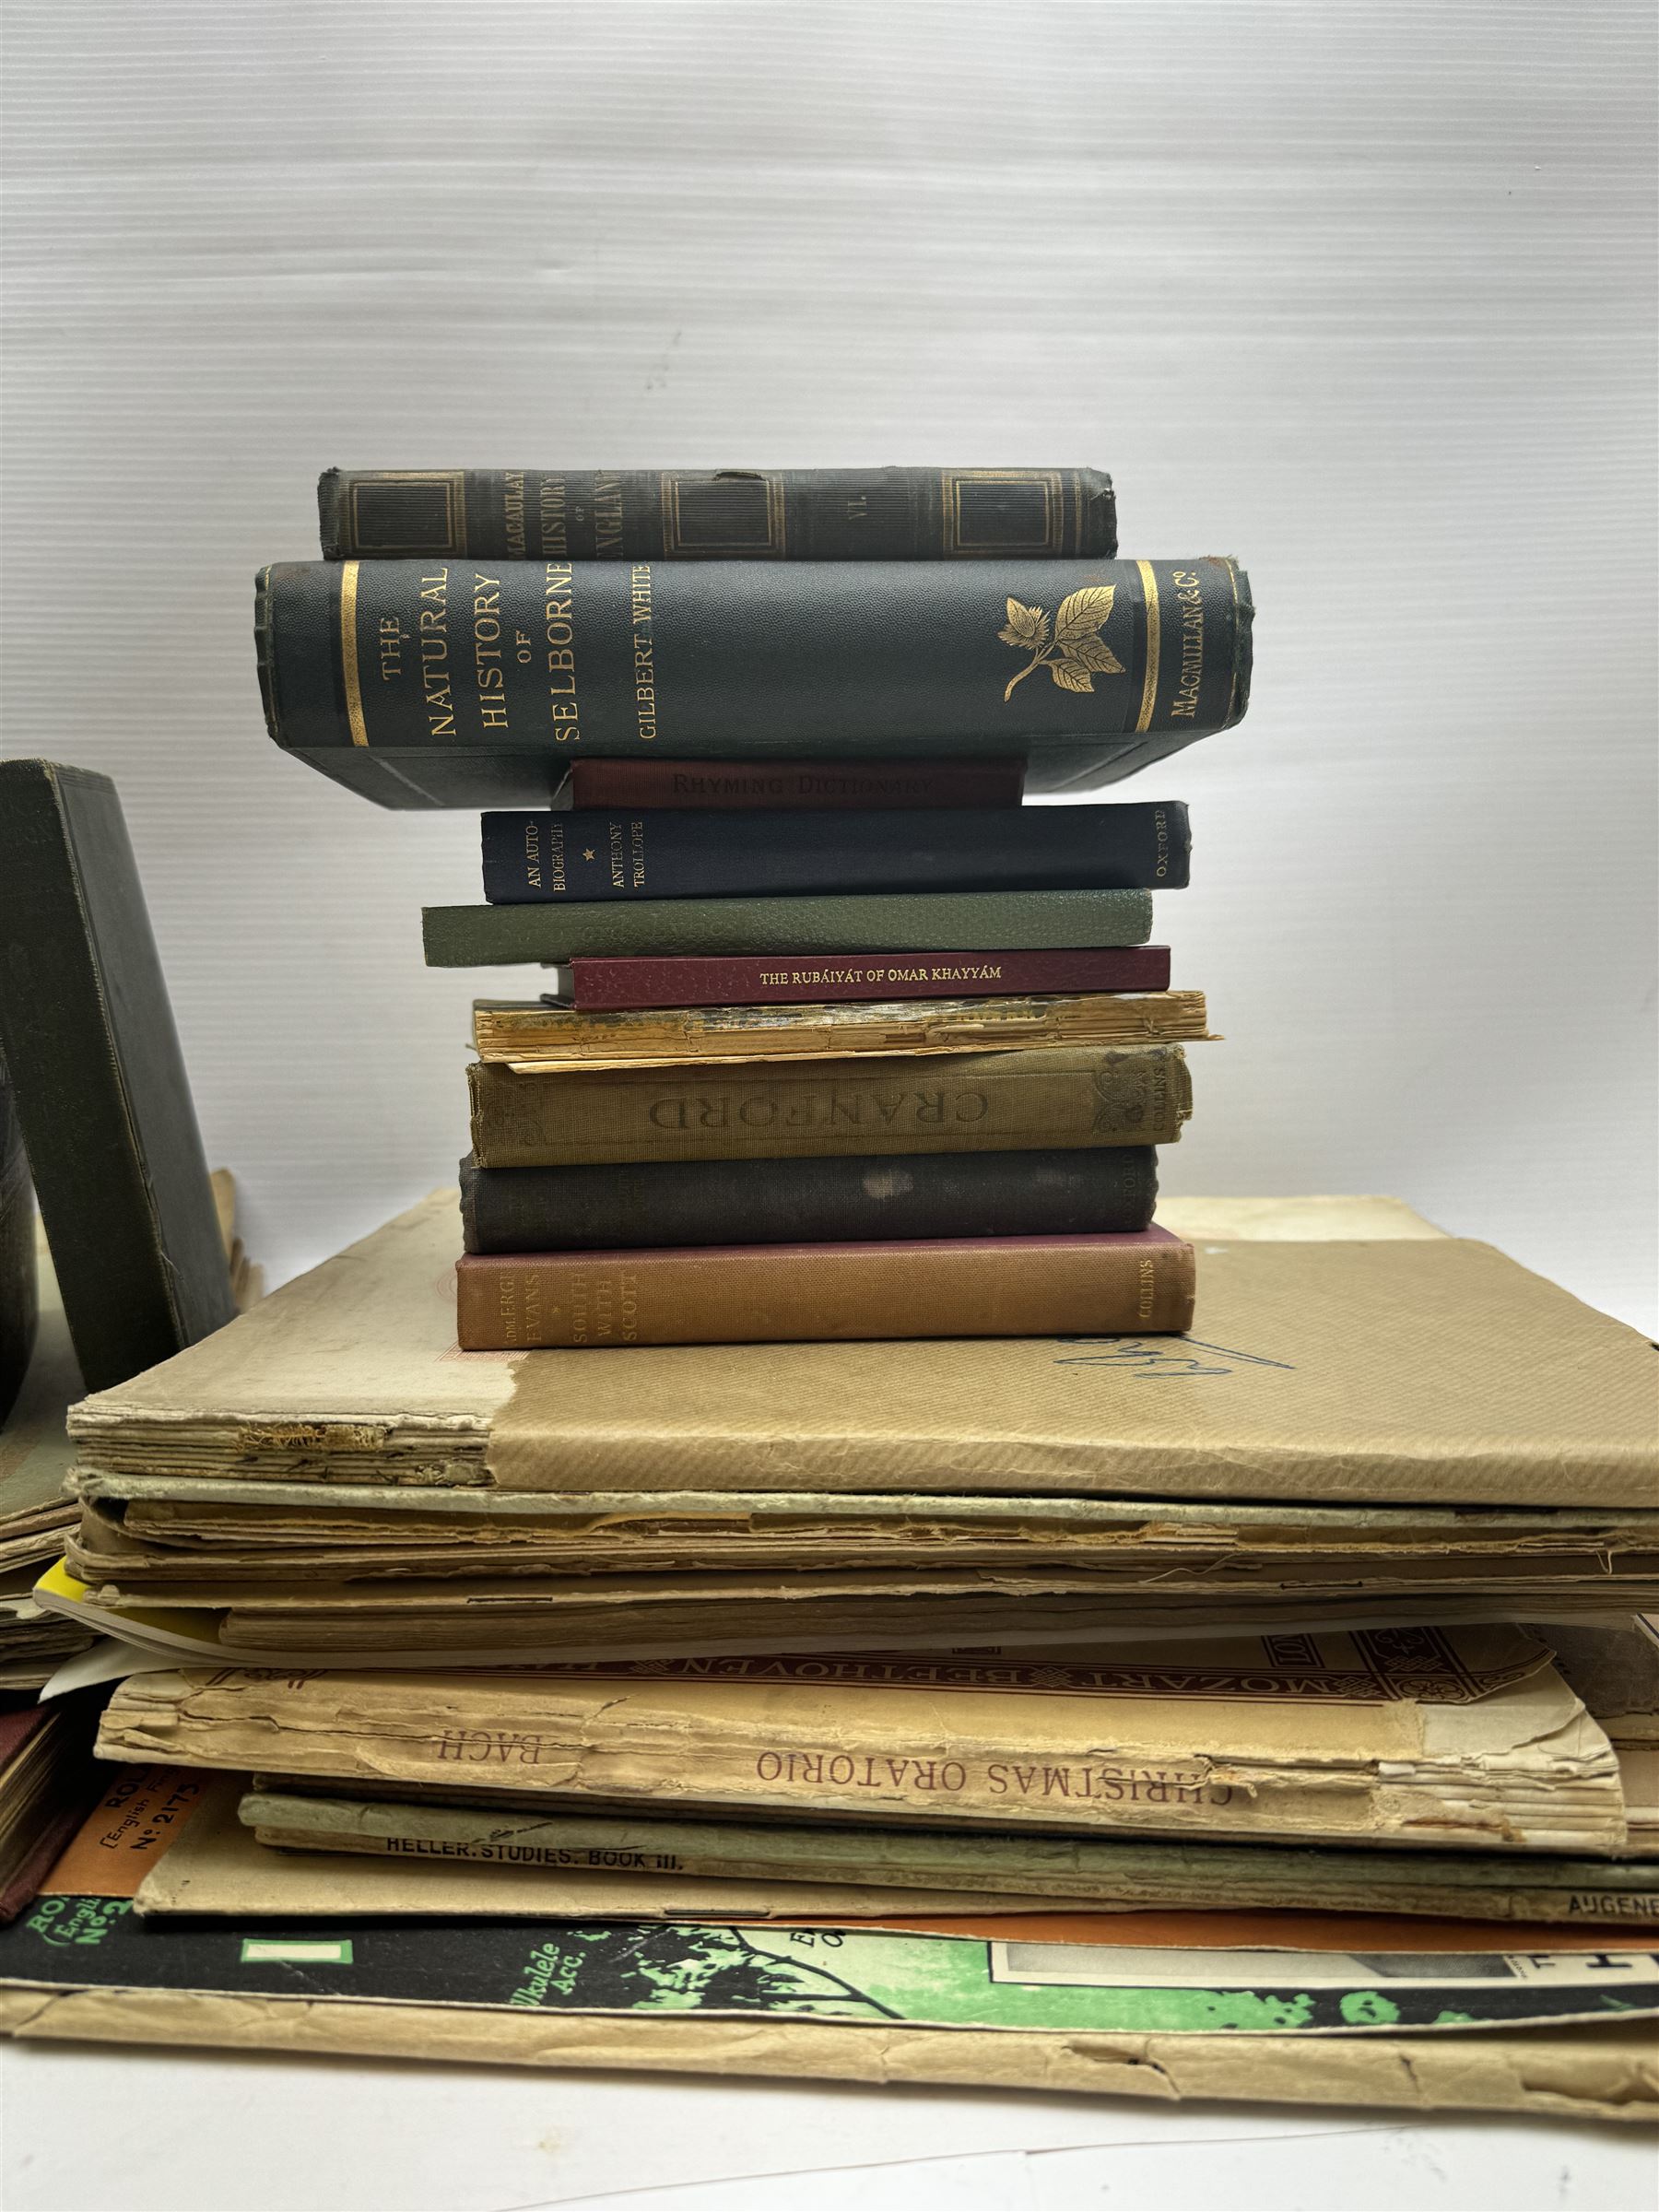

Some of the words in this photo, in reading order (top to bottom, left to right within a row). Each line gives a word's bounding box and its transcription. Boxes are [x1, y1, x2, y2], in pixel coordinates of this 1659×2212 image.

[503, 471, 525, 559] MACAULAY
[575, 505, 585, 522] OF
[847, 495, 868, 521] VI.
[630, 563, 652, 625] WHITE
[379, 616, 401, 682] THE
[418, 566, 458, 737] NATURAL
[474, 572, 510, 730] HISTORY
[514, 629, 532, 664] OF
[545, 561, 582, 742] SELBORNE
[1171, 606, 1204, 719] MACMILLAN
[633, 634, 657, 740] GILBERT
[672, 773, 784, 795] RHYMING
[798, 773, 933, 795] DICTIONARY
[525, 819, 541, 865] AUTO-
[551, 823, 566, 892] BIOGRAPHY
[609, 821, 625, 889] ANTHONY
[630, 820, 646, 888] TROLLOPE
[1154, 808, 1170, 878] OXFORD
[527, 866, 542, 889] AN
[759, 972, 789, 985] THE
[792, 968, 864, 984] RUBÁIYÁT
[866, 970, 885, 982] OF
[888, 969, 929, 982] OMAR
[931, 965, 1002, 980] KHAYYÁM
[648, 1090, 990, 1133] CRANFORD
[1152, 1067, 1167, 1133] COLLINS
[524, 1272, 542, 1343] EVANS
[571, 1273, 588, 1344] SOUTH
[598, 1279, 613, 1338] WITH
[620, 1271, 638, 1343] SCOTT
[1138, 1258, 1155, 1321] COLLINS
[680, 1657, 1023, 1684] BEETHOVEN
[1080, 1669, 1332, 1695] MOZART
[436, 1728, 542, 1764] BACH
[757, 1750, 968, 1792] ORATORIO
[988, 1762, 1234, 1807] CHRISTMAS
[100, 1798, 150, 1850] [English
[386, 1836, 478, 1858] HELLER.
[480, 1843, 581, 1866] STUDIES.
[588, 1849, 647, 1869] BOOK
[24, 1898, 70, 1935] RO
[40, 1898, 103, 1947] (Engli
[509, 1942, 561, 2006] Ukulele
[548, 1950, 588, 1997] Acc.
